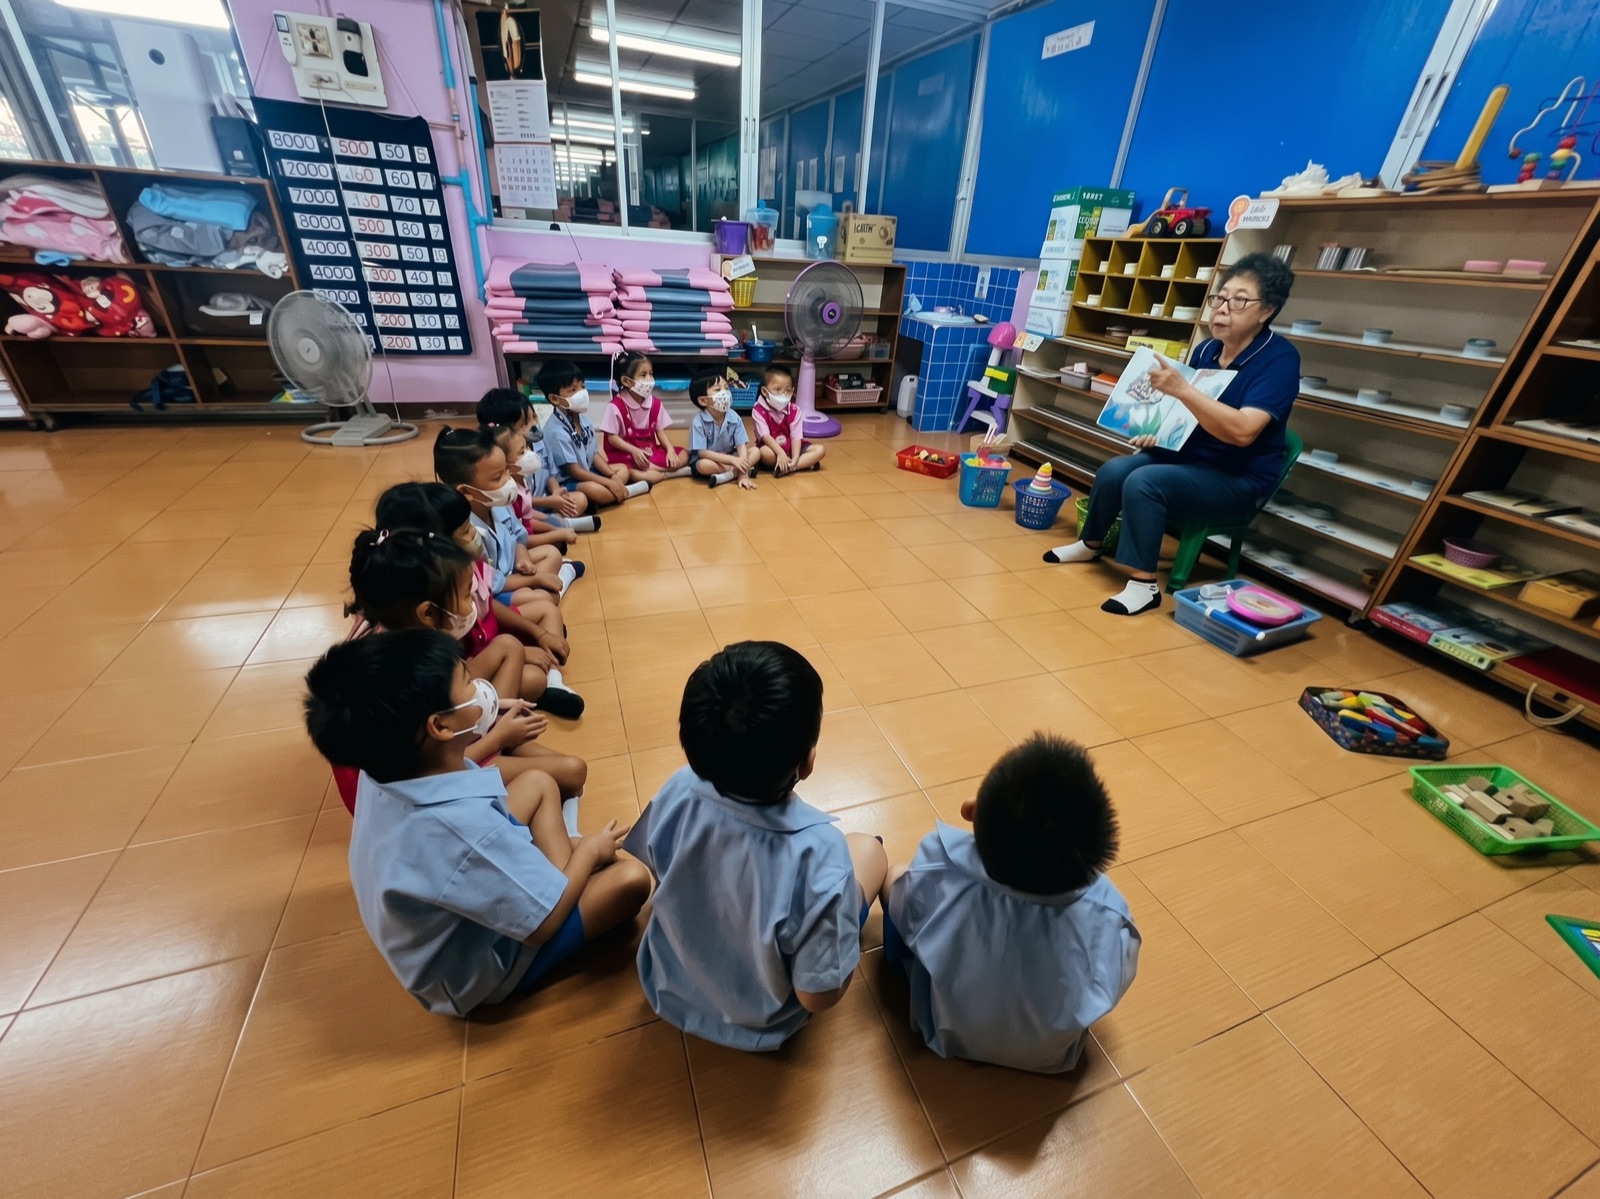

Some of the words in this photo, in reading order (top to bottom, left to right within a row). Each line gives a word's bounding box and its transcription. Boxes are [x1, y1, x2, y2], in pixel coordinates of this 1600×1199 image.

[272, 132, 315, 150] 8000
[338, 140, 368, 156] 500
[385, 144, 404, 159] 50
[286, 161, 329, 178] 2000
[391, 171, 410, 186] 60
[420, 173, 428, 187] 7
[292, 188, 336, 204] 7000
[395, 197, 414, 212] 70
[427, 200, 435, 214] 7
[299, 214, 341, 230] 8000
[358, 218, 385, 233] 500
[401, 222, 420, 236] 80
[306, 241, 347, 255] 4000
[406, 247, 424, 260] 50
[313, 266, 354, 280] 4000
[371, 268, 397, 282] 300
[410, 271, 428, 284] 40
[375, 292, 401, 305] 300
[380, 314, 407, 326] 200
[420, 315, 437, 327] 30
[386, 336, 412, 348] 200
[424, 337, 441, 349] 30
